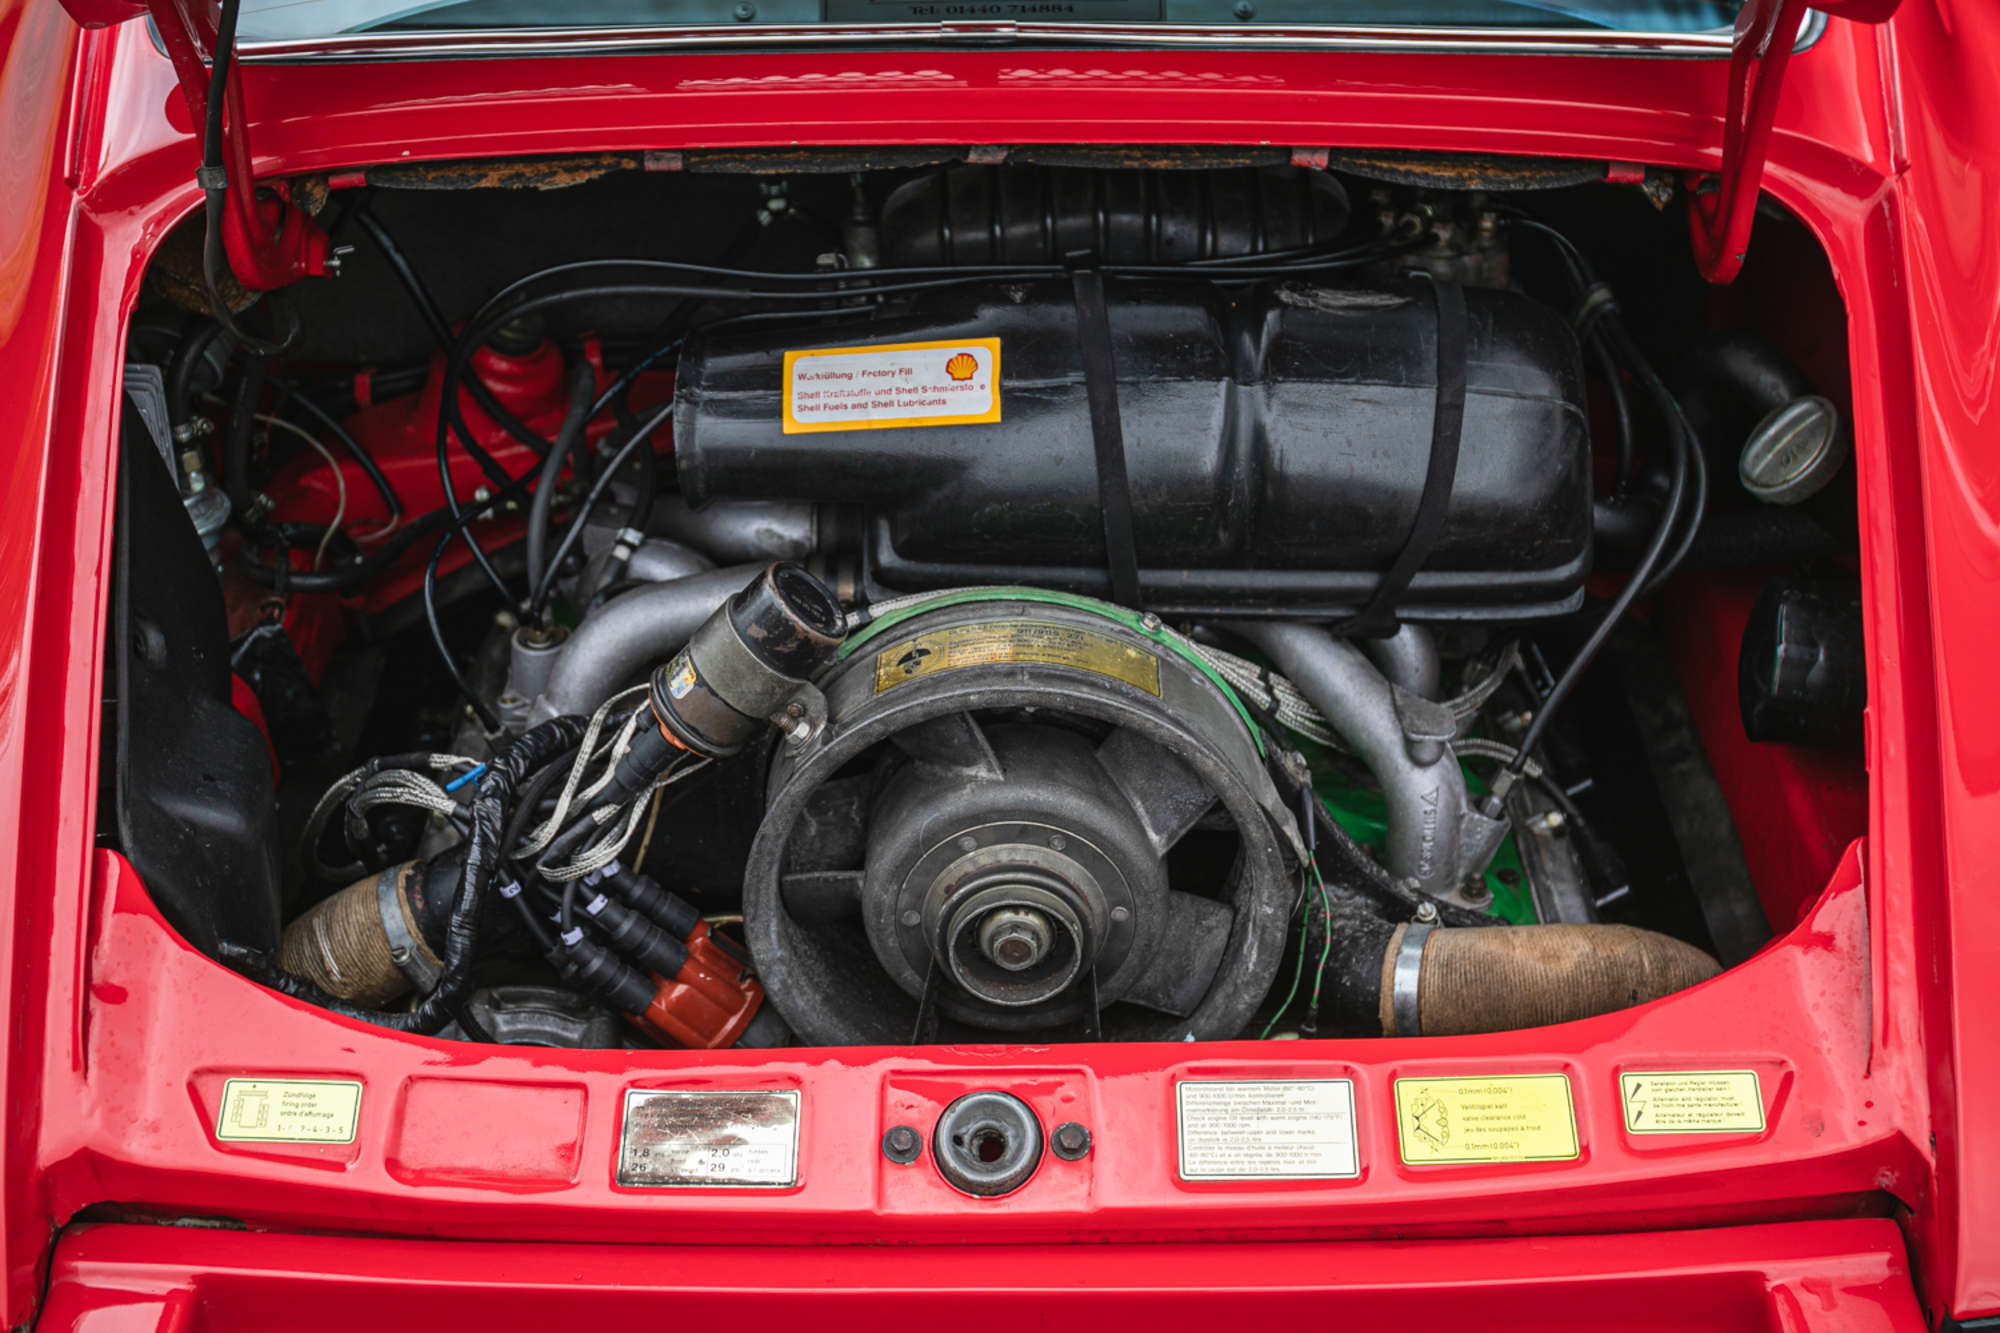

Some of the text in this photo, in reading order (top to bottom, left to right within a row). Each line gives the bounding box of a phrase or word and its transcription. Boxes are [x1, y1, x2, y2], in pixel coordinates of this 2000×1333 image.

[945, 5, 1001, 14] 01440
[1008, 4, 1074, 14] 714884
[898, 367, 912, 376] Fill
[874, 387, 892, 396] und
[895, 385, 918, 395] Shell
[797, 404, 820, 412] Shell
[823, 402, 848, 412] Fuels
[850, 401, 868, 410] and
[871, 399, 894, 408] Shell
[632, 1162, 647, 1172] 26
[710, 1162, 726, 1172] 29
